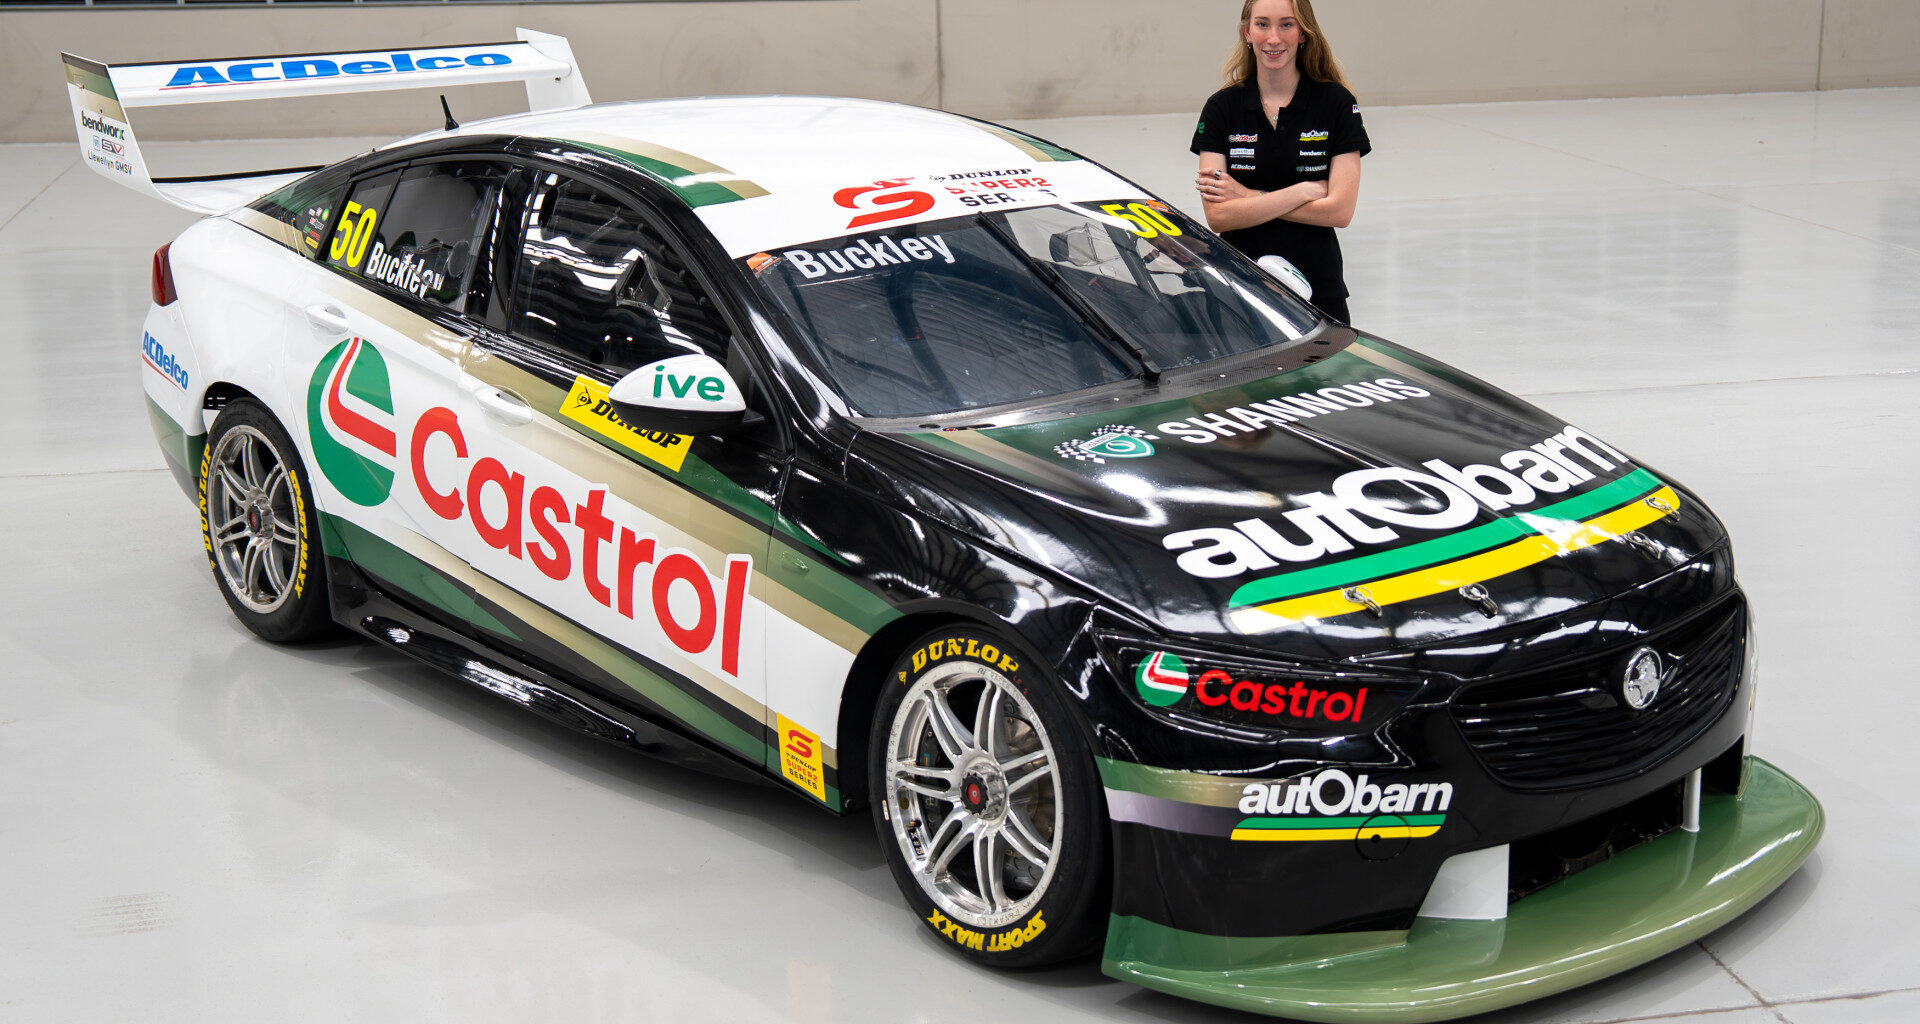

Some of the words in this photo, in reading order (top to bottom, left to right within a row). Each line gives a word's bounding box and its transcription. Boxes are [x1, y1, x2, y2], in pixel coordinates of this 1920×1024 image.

[166, 53, 513, 87] ACDelco
[81, 108, 125, 141] bendworx
[949, 168, 1033, 180] DUNLOP
[330, 200, 377, 268] 50
[1099, 202, 1183, 239] 50
[782, 235, 956, 279] Buckley
[143, 331, 189, 390] ACDelco
[653, 364, 725, 402] ive
[1157, 378, 1431, 444] SHANNONS
[199, 443, 213, 553] DUNLOP
[1162, 424, 1630, 579] autObarn
[410, 406, 749, 678] Castrol
[911, 638, 1019, 674] DUNLOP
[1196, 669, 1367, 723] Castrol
[786, 758, 818, 782] SUPER2
[788, 767, 818, 790] SERIES
[790, 754, 817, 772] DUNLOP
[1238, 769, 1453, 815] autObarn
[926, 908, 985, 951] MAXX
[986, 909, 1047, 952] SPORT
